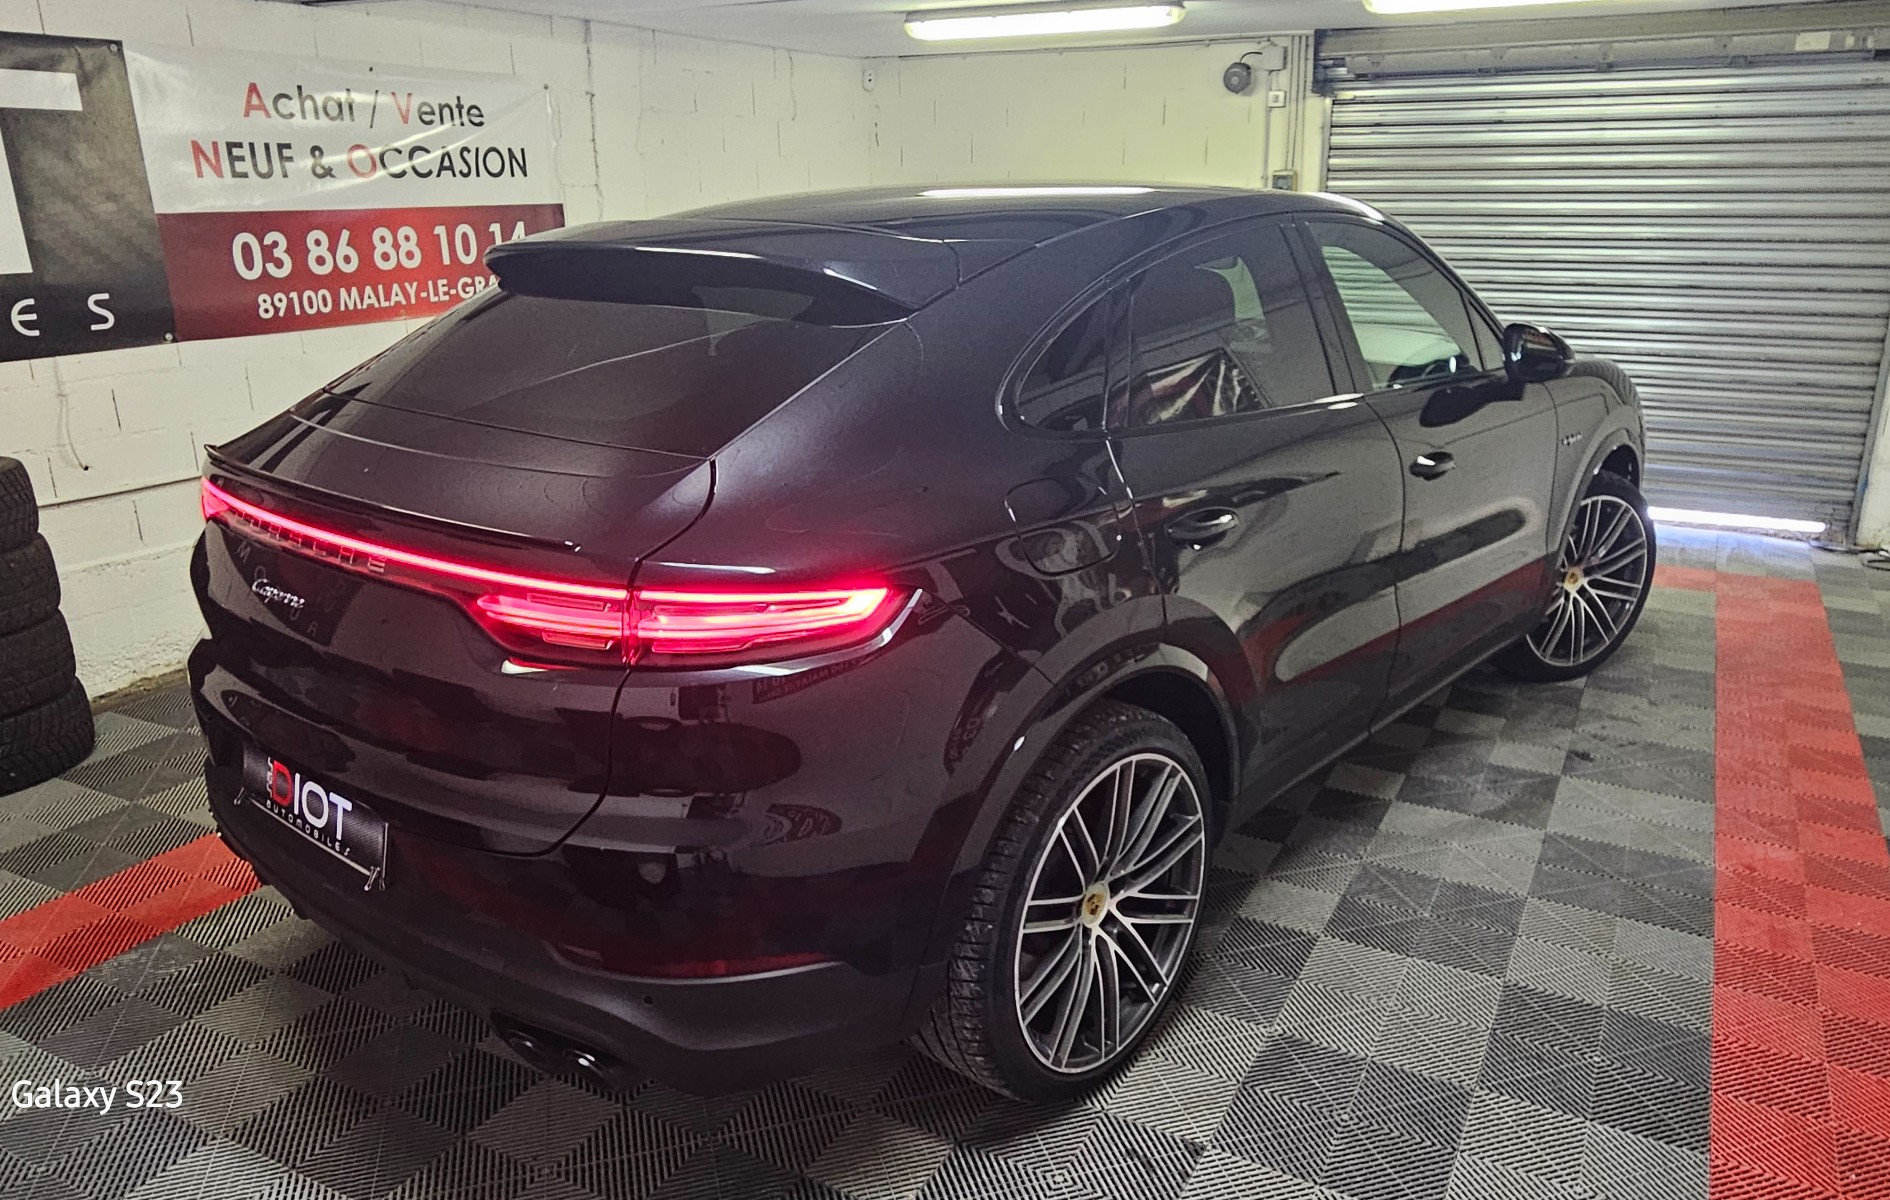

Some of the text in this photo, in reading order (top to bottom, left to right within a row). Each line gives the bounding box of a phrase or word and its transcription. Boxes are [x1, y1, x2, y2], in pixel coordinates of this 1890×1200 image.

[243, 82, 355, 122] Achat
[391, 91, 485, 127] Vente
[191, 140, 528, 179] NEUF & OCCASION
[232, 231, 293, 280] 03
[306, 228, 359, 275] 86
[372, 226, 422, 270] 88
[434, 223, 477, 265] 10
[257, 289, 332, 319] 89100
[272, 760, 352, 840] DIOT
